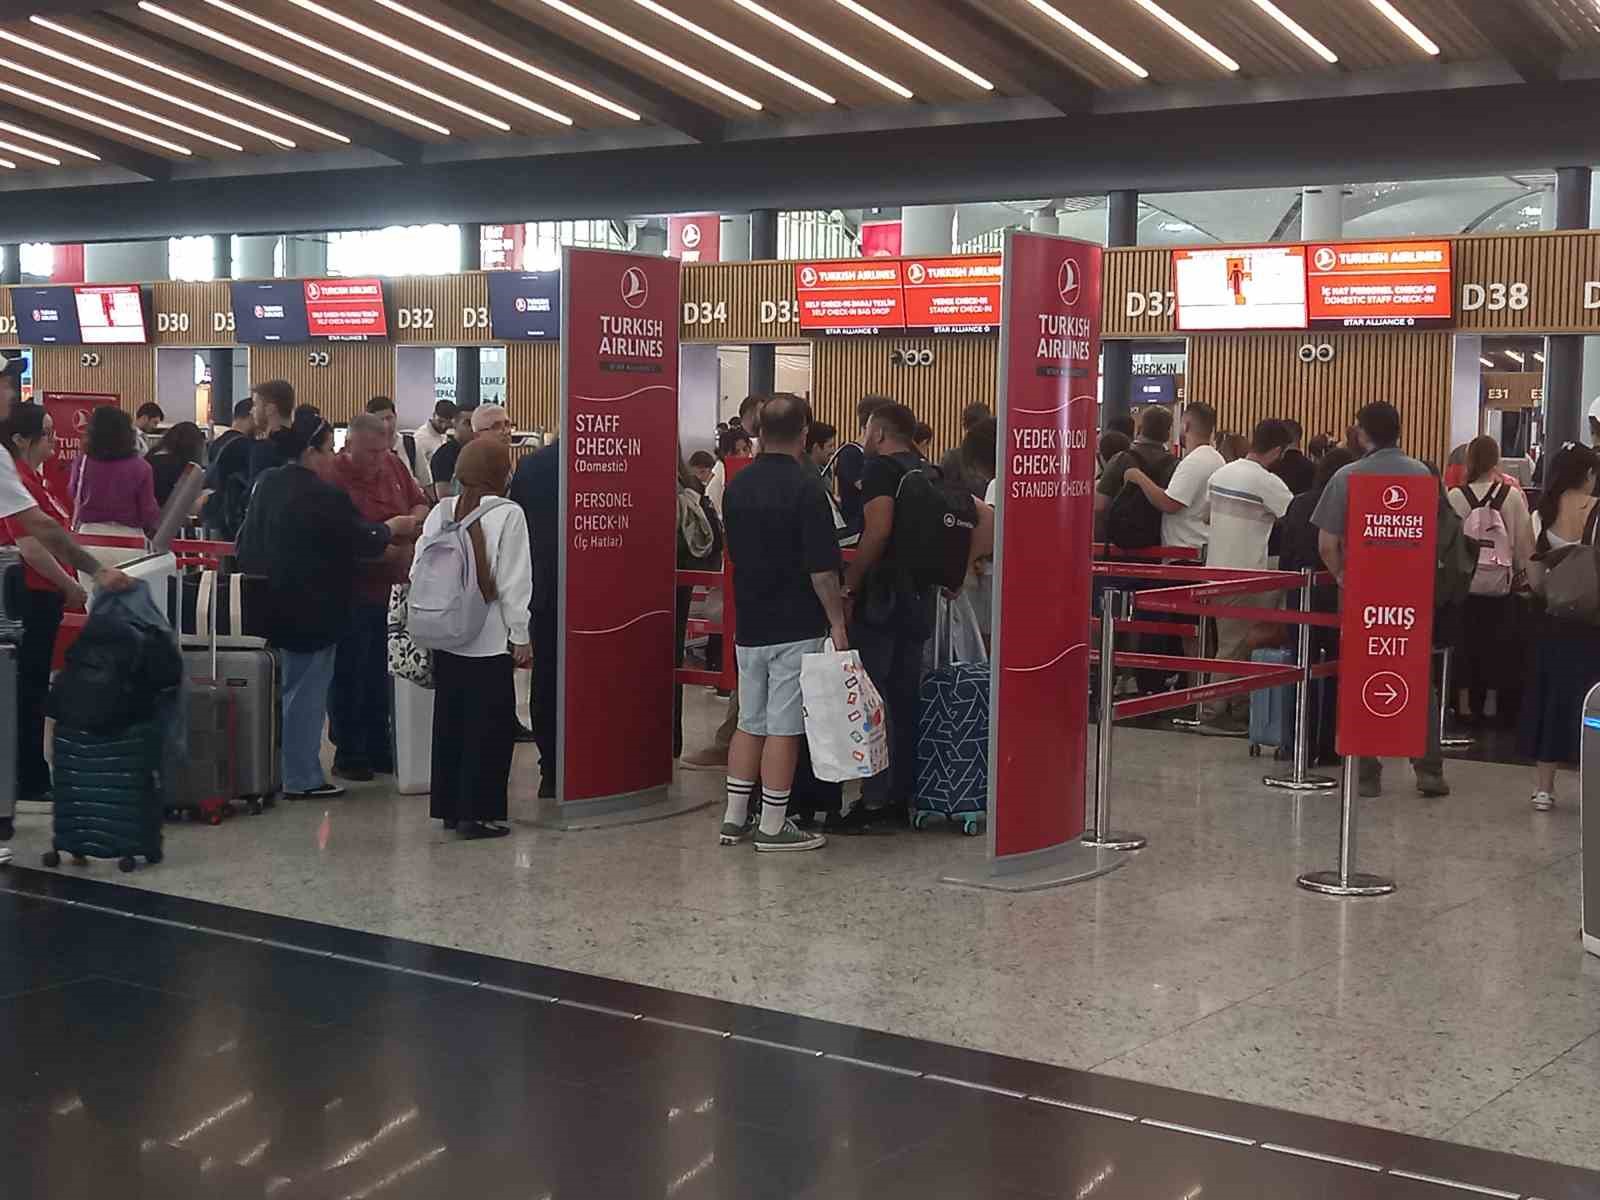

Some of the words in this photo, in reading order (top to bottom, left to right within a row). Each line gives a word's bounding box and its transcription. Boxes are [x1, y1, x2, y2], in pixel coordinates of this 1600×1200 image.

[1126, 291, 1175, 316] D37
[1462, 283, 1528, 310] D38
[158, 313, 189, 332] D30
[214, 313, 236, 331] D3
[398, 308, 434, 328] D32
[463, 308, 492, 327] D3
[684, 302, 727, 324] D34
[0, 316, 18, 333] D2
[600, 316, 663, 336] TURKISH
[1039, 314, 1090, 337] TURKISH
[600, 337, 663, 357] AIRLINES
[1037, 338, 1089, 360] AIRLINES
[1488, 389, 1509, 399] E31
[575, 414, 620, 432] STAFF
[575, 438, 640, 456] CHECK-IN
[1013, 429, 1056, 449] YEDEK
[1058, 430, 1088, 449] YOLCU
[574, 460, 628, 472] (Domestic)
[1013, 455, 1071, 475] CHECK-IN
[1012, 481, 1060, 498] STANDBY
[575, 493, 633, 508] PERSONEL
[574, 515, 630, 530] CHECK-IN
[1365, 514, 1423, 526] TURKISH
[1363, 526, 1423, 538] AIRLINES
[1363, 605, 1416, 630] ÇIKIŞ
[1368, 637, 1408, 657] EXIT
